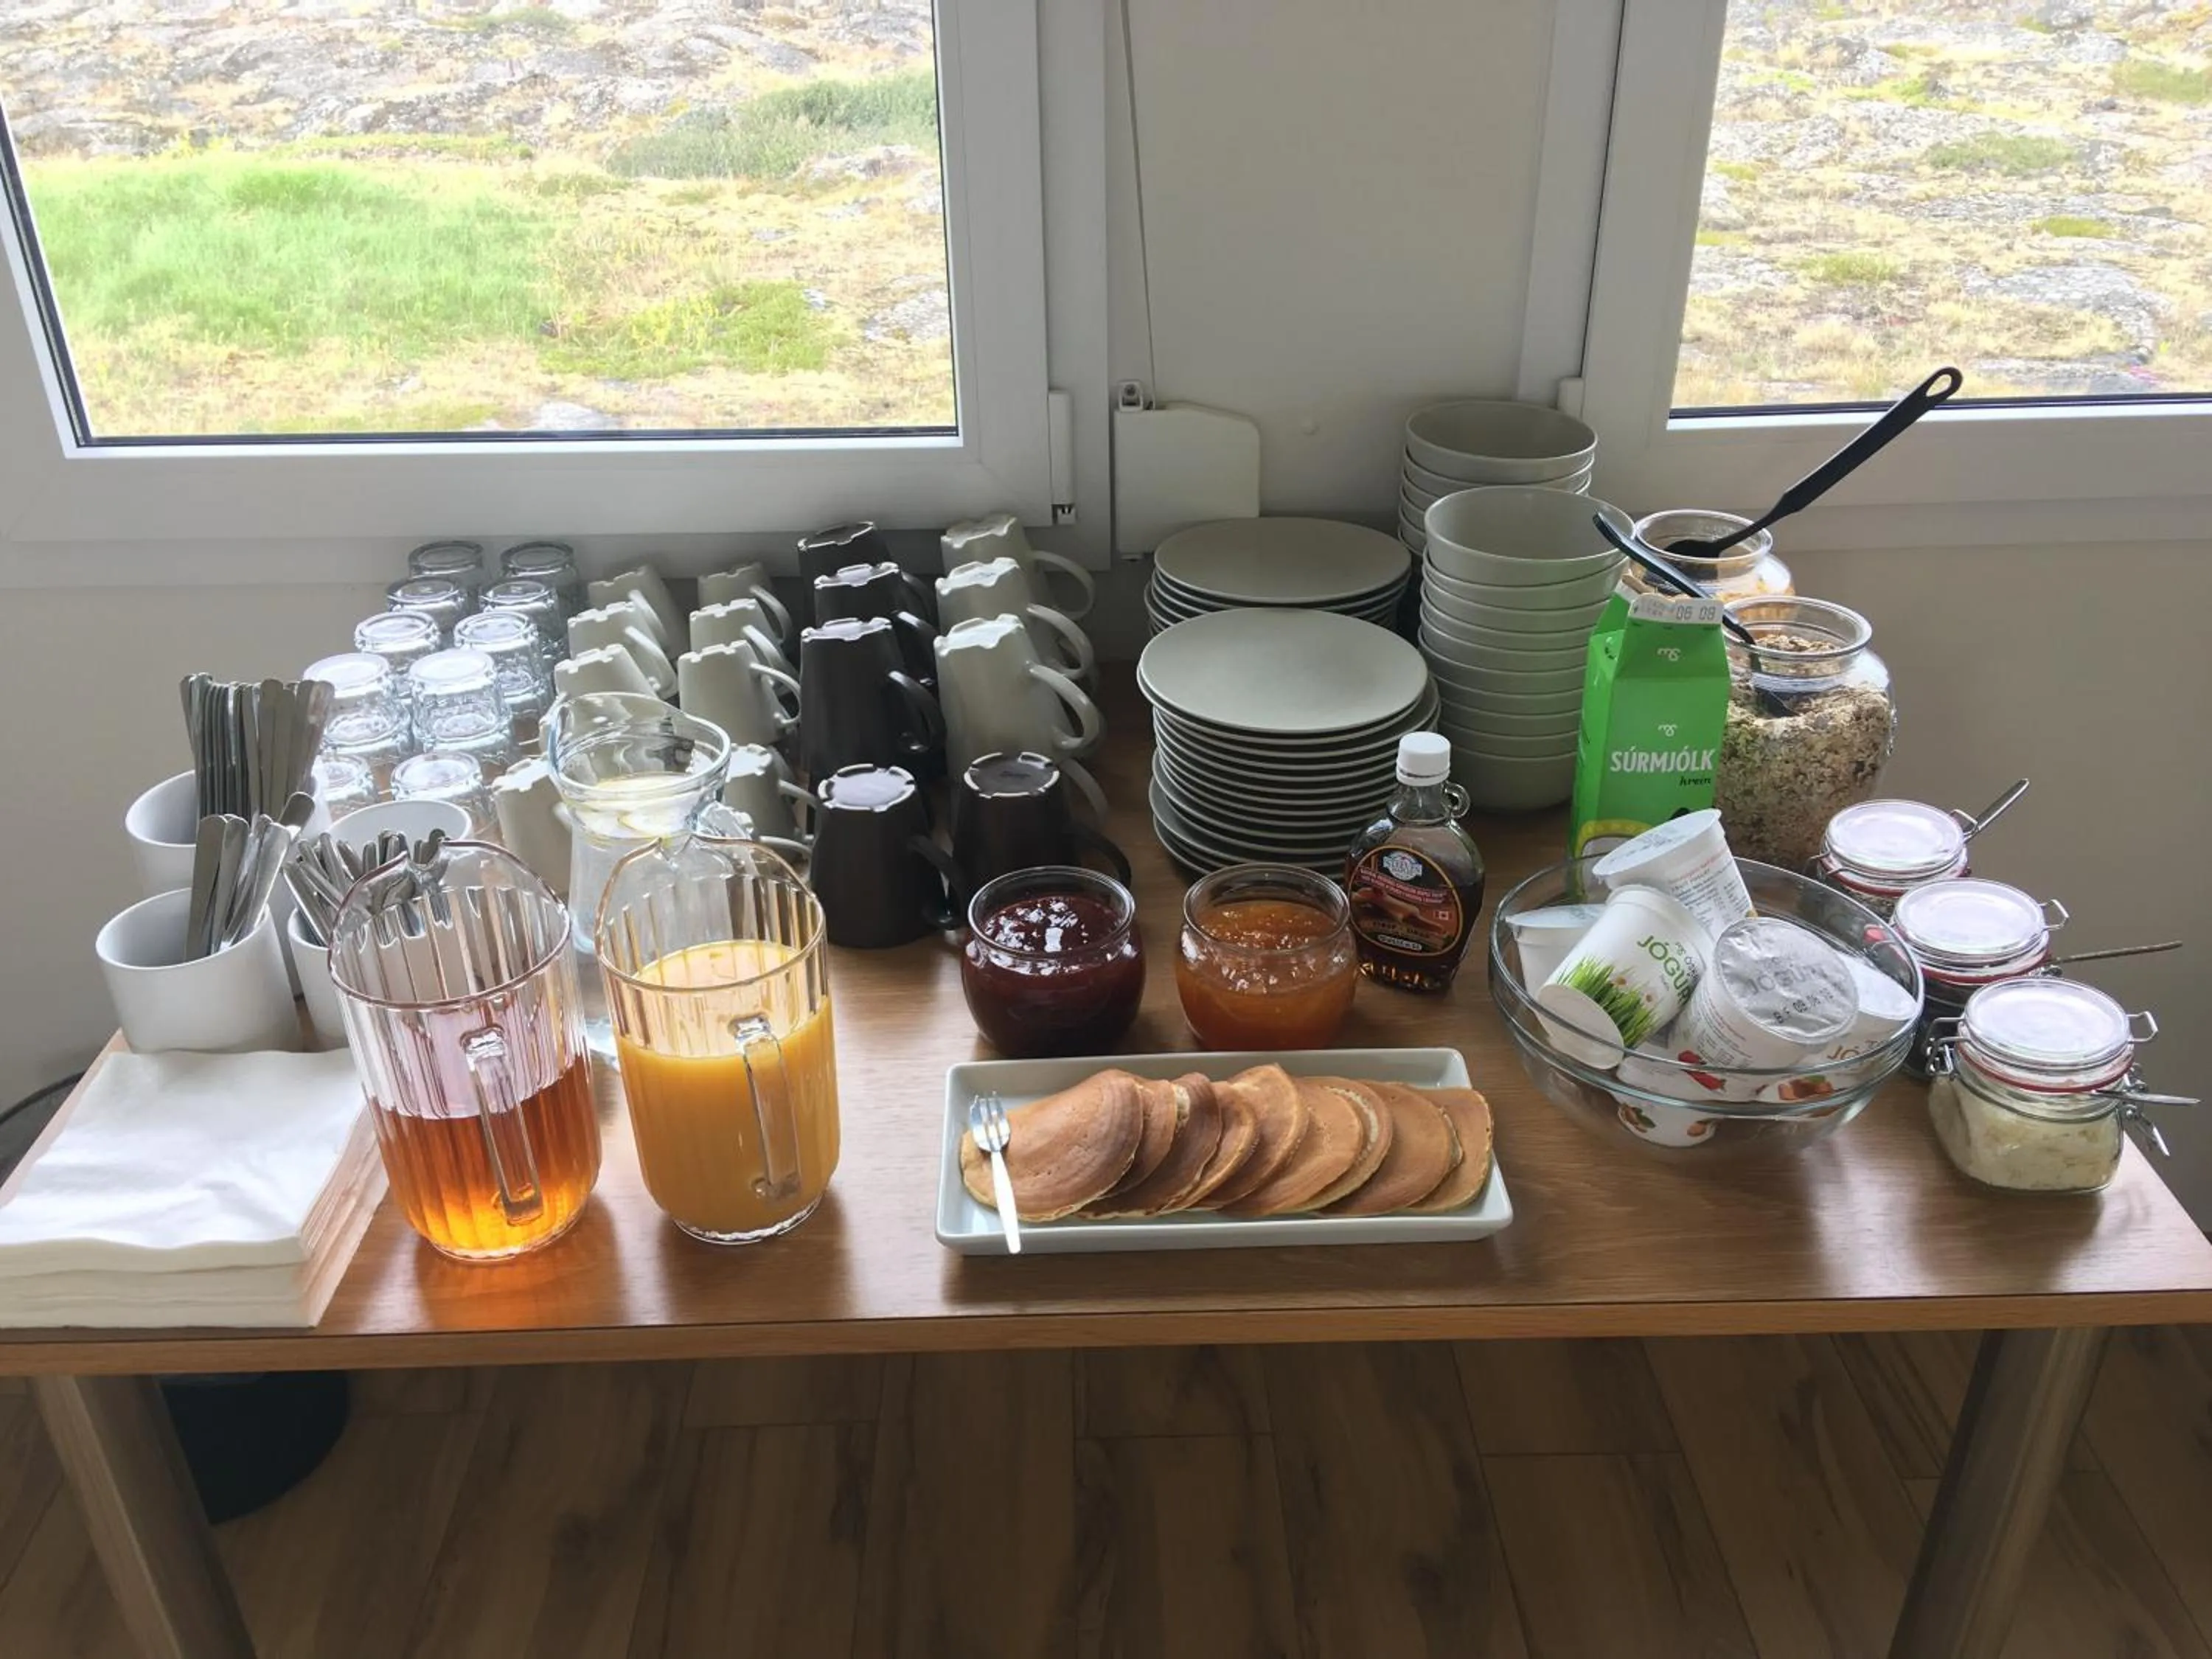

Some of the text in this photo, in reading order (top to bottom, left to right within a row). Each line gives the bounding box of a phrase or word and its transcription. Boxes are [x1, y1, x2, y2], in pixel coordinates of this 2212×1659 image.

[1676, 605, 1692, 620] 06
[1610, 745, 1716, 773] SÚRMJÓLK
[1637, 935, 1694, 1004] JÓGÚR
